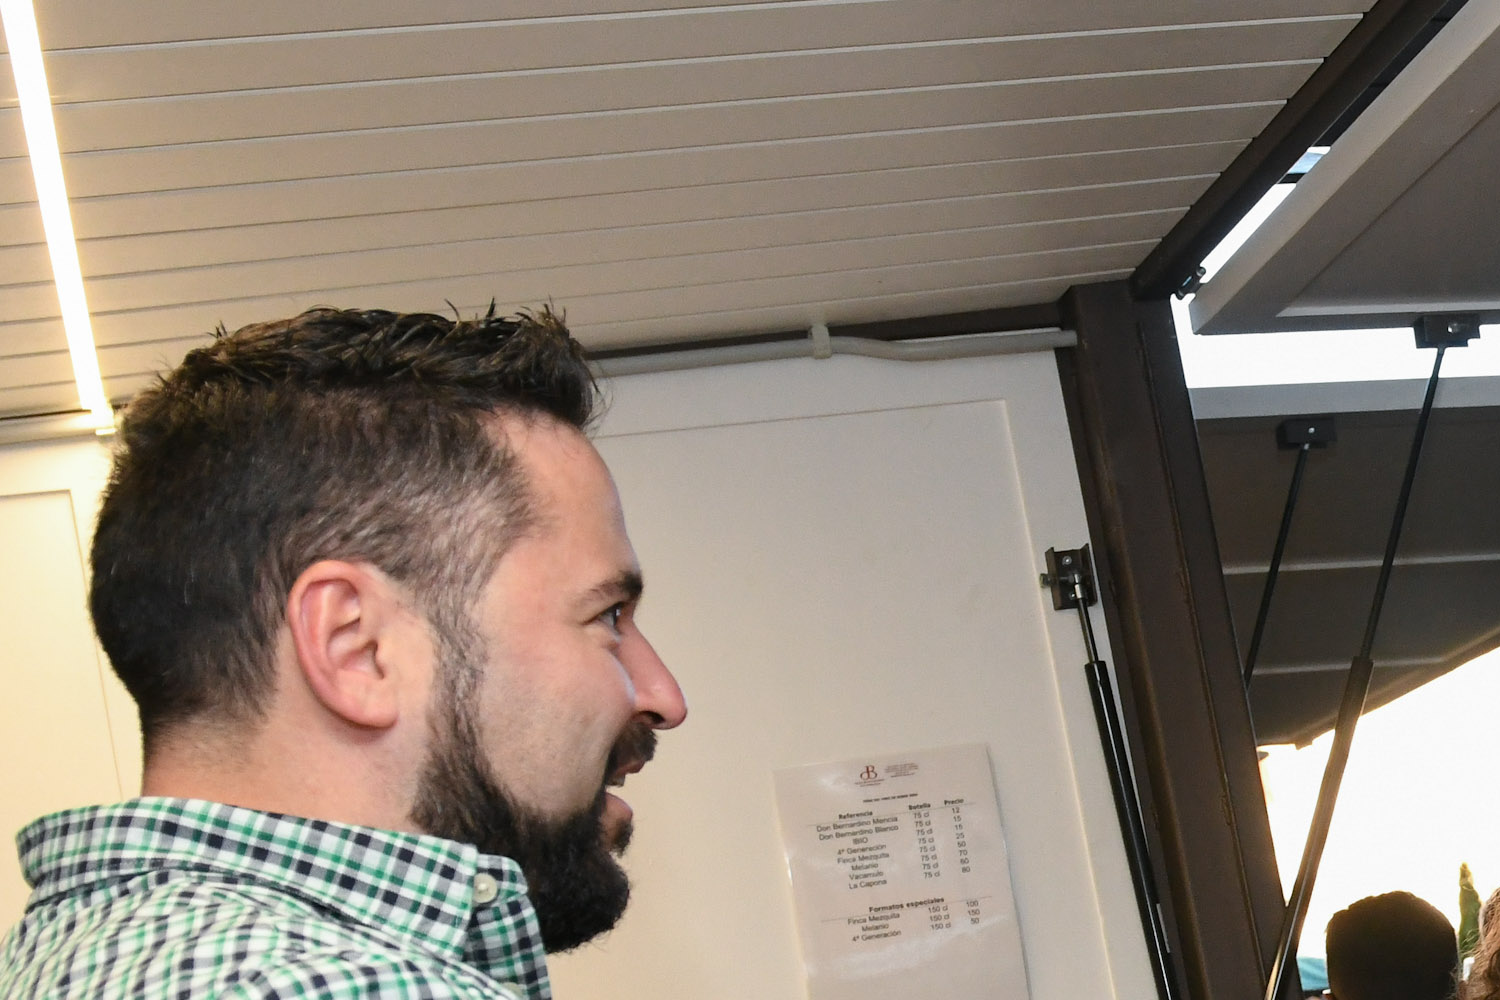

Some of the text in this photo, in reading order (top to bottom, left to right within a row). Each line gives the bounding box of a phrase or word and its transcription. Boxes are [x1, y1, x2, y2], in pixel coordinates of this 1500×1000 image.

[838, 811, 872, 820] Referencia
[833, 821, 871, 830] Bernardino
[835, 829, 873, 838] Bernardino
[869, 897, 944, 913] Formatos especiales
[848, 917, 867, 925] Finca
[869, 912, 900, 922] Mezquita
[930, 914, 942, 922] 150
[861, 930, 901, 941] Generación
